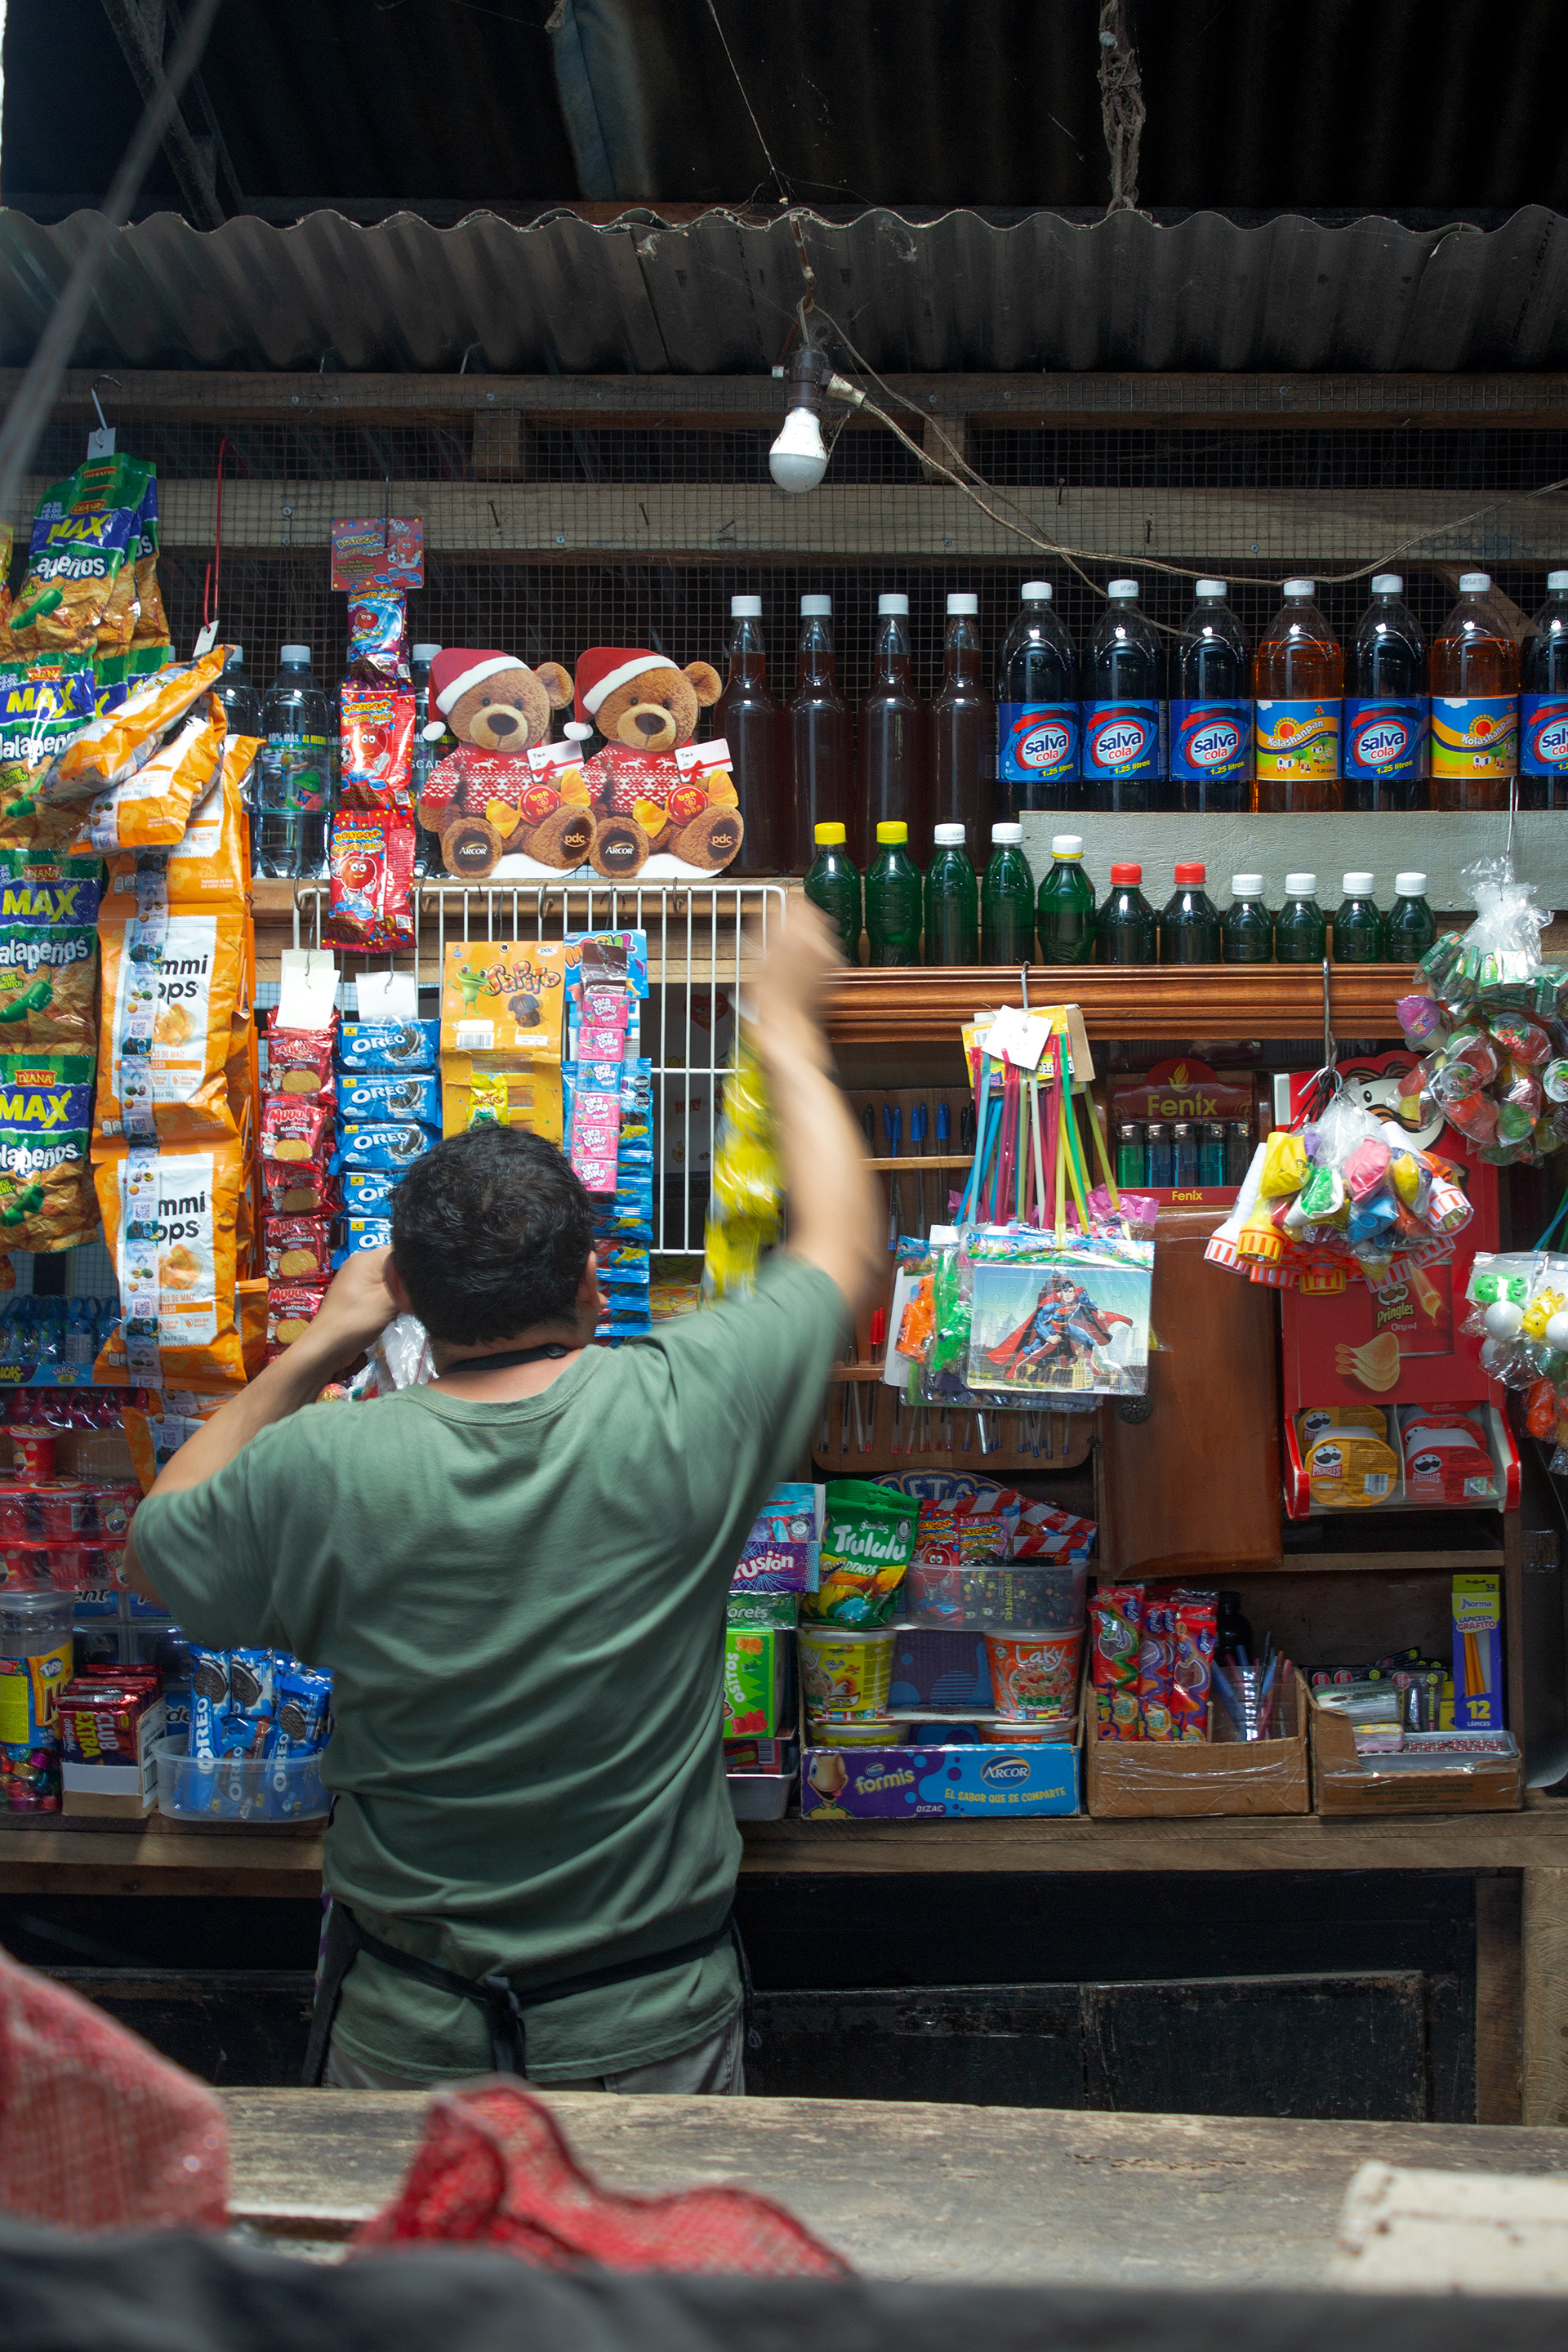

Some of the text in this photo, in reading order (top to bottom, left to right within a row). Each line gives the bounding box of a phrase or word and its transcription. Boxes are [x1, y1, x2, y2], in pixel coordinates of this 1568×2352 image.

[46, 514, 112, 544] MAX
[336, 533, 382, 548] BOLYGOMA
[336, 547, 363, 558] Cereza
[36, 556, 105, 579] apeños
[349, 592, 377, 602] Cereza
[7, 678, 77, 719] MAX
[344, 701, 391, 713] BOLYGOMA
[341, 714, 369, 724] Cereza
[268, 733, 310, 743] 40% MÁS AL
[1267, 720, 1324, 747] Kolashanpan
[1461, 717, 1513, 746] Kolashanpan
[1025, 734, 1068, 755] salva
[1098, 731, 1142, 752] salva
[1193, 732, 1237, 753] salva
[1361, 728, 1405, 751] salva
[1036, 749, 1059, 762] cola
[1108, 746, 1132, 760] cola
[1204, 746, 1227, 760] cola
[1370, 744, 1395, 759] cola
[1041, 763, 1074, 777] 1.25 litros
[1114, 760, 1151, 775] 1.25 litros
[1209, 760, 1245, 776] 1.25 litros
[1376, 760, 1413, 774] 1.25 litros
[1558, 763, 1568, 771] 1.2
[529, 791, 548, 801] bon
[677, 791, 696, 801] bon
[537, 804, 555, 815] bon
[684, 804, 702, 815] bon
[335, 829, 381, 842] BOLYGOMA
[565, 833, 585, 844] pdc
[712, 833, 732, 844] pdc
[332, 843, 361, 853] Cereza
[459, 846, 488, 855] ARCOR
[605, 846, 633, 855] ARCOR
[26, 869, 59, 878] DIANA
[2, 884, 79, 922] MAX
[0, 939, 90, 970] alapeños
[161, 954, 208, 975] mmi
[1485, 954, 1494, 979] Clorets
[158, 980, 198, 1004] ops
[352, 1035, 406, 1054] OREO
[17, 1073, 54, 1084] DIANA
[350, 1085, 407, 1104] OREO
[0, 1089, 72, 1128] MAX
[1147, 1091, 1218, 1117] Fenix
[280, 1126, 314, 1134] MANTEQUILLA
[353, 1133, 408, 1151] OREO
[0, 1143, 79, 1172] lapeños
[358, 1187, 390, 1202] OR
[1172, 1190, 1203, 1200] Fenix
[158, 1190, 205, 1216] mmi
[158, 1220, 199, 1245] ops
[359, 1232, 391, 1249] OR
[180, 1293, 194, 1302] MAÍZ
[1376, 1302, 1414, 1328] Pringles
[1391, 1322, 1418, 1331] Original
[1312, 1466, 1341, 1477] PRINGLES
[1412, 1473, 1441, 1483] PRINGLES
[859, 1521, 889, 1534] gomitas
[918, 1518, 953, 1530] OLYGOMA
[959, 1523, 1001, 1536] OLYGOMA
[833, 1525, 906, 1561] Trululu
[937, 1532, 955, 1540] WILD
[959, 1537, 1002, 1551] OGU Fresa
[844, 1561, 879, 1576] DINOS
[1004, 1573, 1013, 1621] BOTONETAS
[1459, 1597, 1492, 1610] Norma
[727, 1606, 768, 1619] orets
[1457, 1621, 1495, 1631] GRAFITO
[725, 1652, 746, 1704] OSITOS
[1466, 1700, 1490, 1720] 12
[63, 1717, 77, 1753] ORIGINAL
[75, 1713, 101, 1757] EXTRA
[95, 1714, 120, 1750] CLUB
[196, 1697, 214, 1775] OREO
[273, 1732, 290, 1793] OREO
[229, 1746, 243, 1802] OREO
[982, 1766, 1028, 1779] ARCOR
[855, 1768, 915, 1795] formis
[944, 1787, 1067, 1803] EL SABOR QUE SE COMPARTE
[916, 1805, 944, 1813] DIZAC
